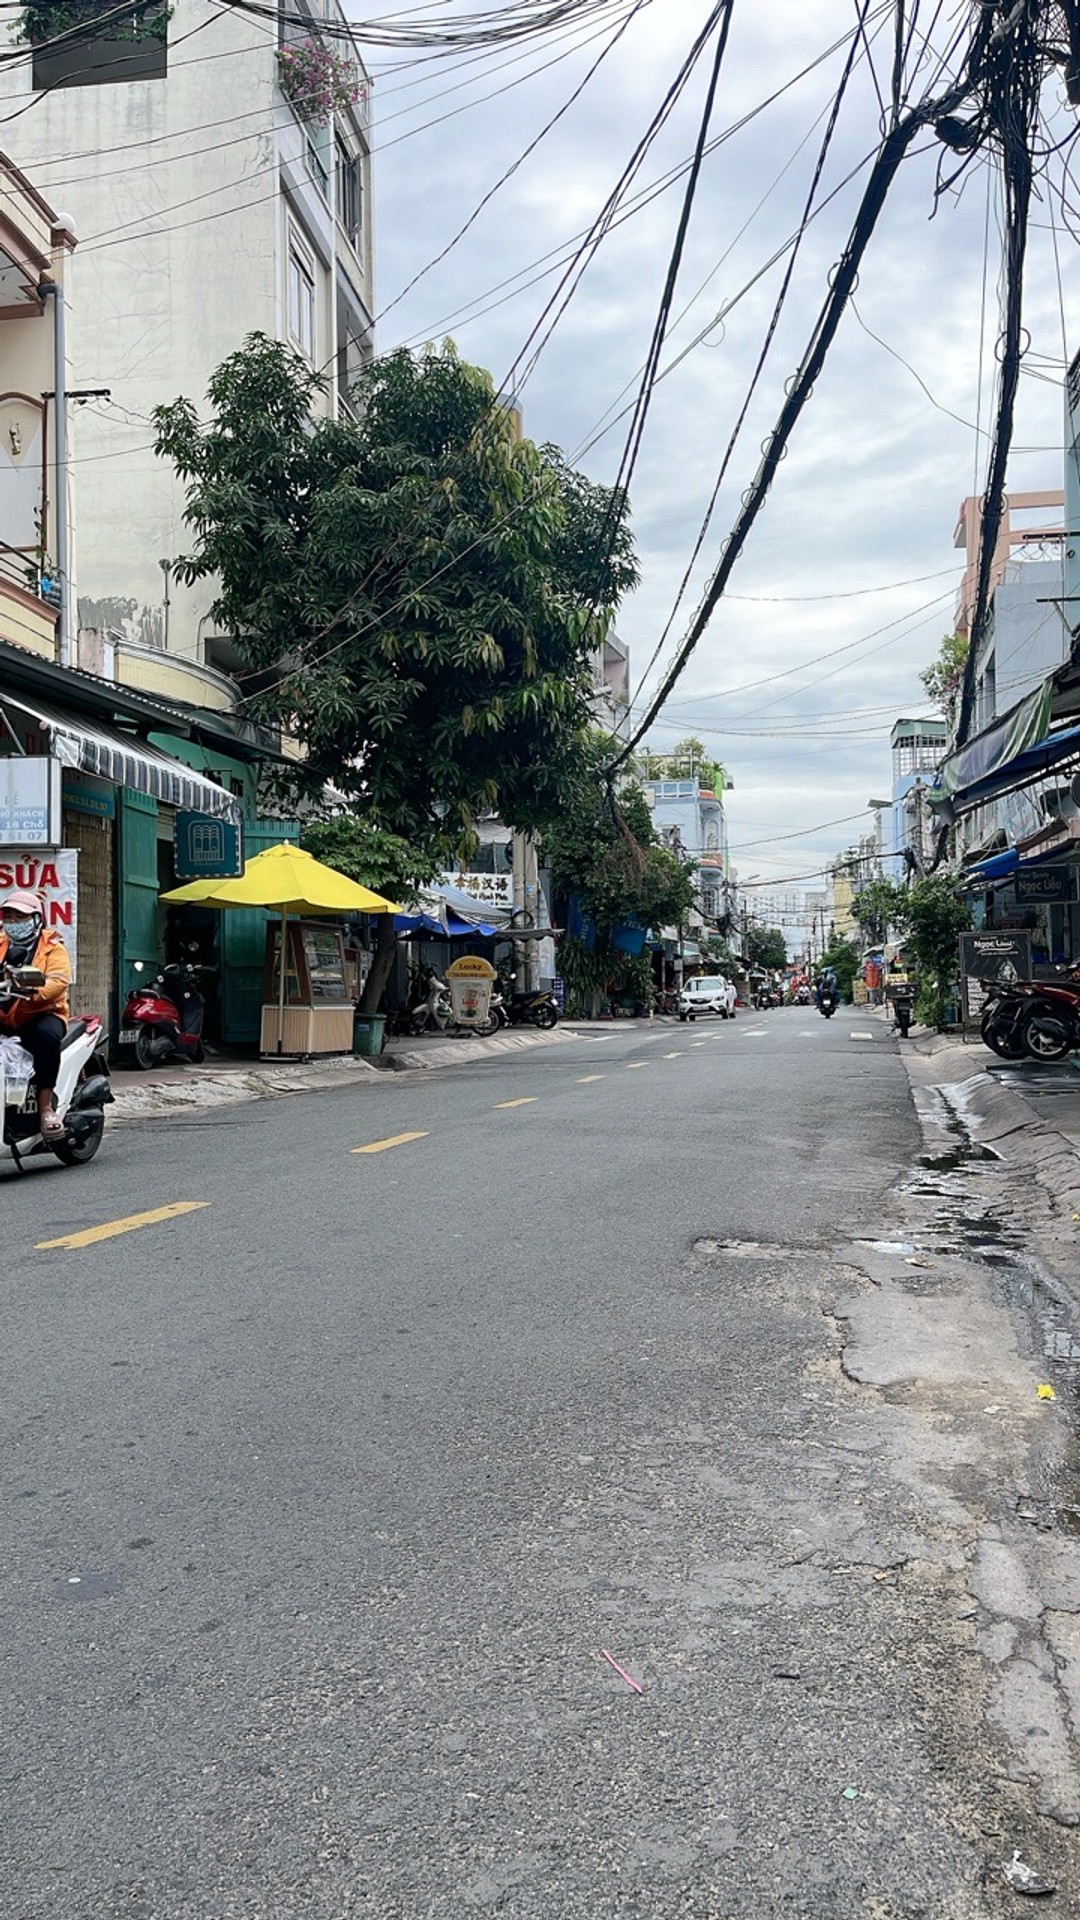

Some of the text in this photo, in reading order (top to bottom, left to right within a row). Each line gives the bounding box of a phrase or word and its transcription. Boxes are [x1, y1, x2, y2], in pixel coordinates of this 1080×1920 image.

[27, 831, 42, 841] 07
[0, 854, 59, 888] SỬA
[458, 963, 482, 971] Lucky
